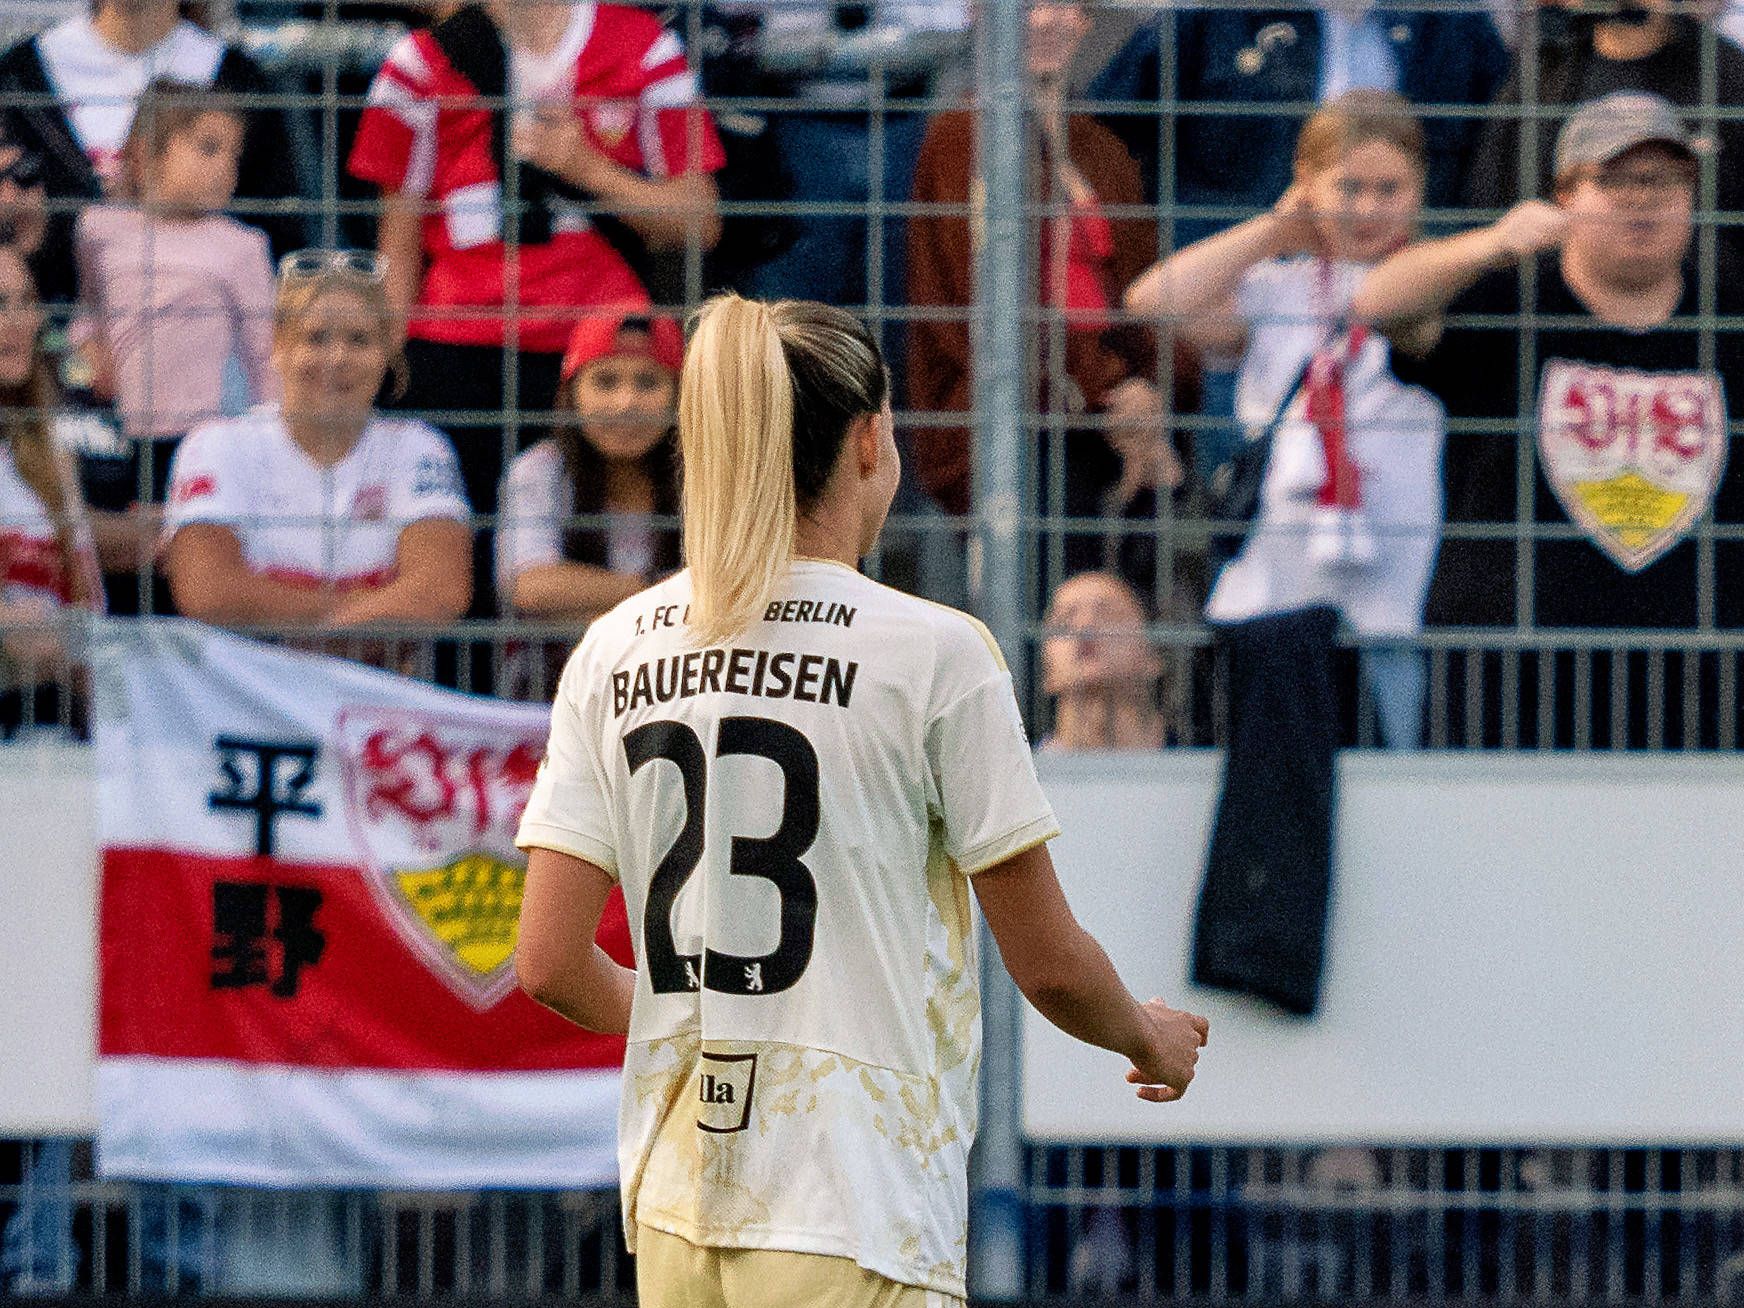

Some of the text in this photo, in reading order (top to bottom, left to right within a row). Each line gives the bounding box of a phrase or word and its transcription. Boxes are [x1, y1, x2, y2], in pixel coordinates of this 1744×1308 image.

[635, 615, 646, 636] 1.
[652, 605, 678, 631] FC
[763, 600, 857, 628] BERLIN
[612, 648, 859, 719] BAUEREISEN
[622, 715, 820, 996] 23
[700, 1074, 736, 1104] lla
